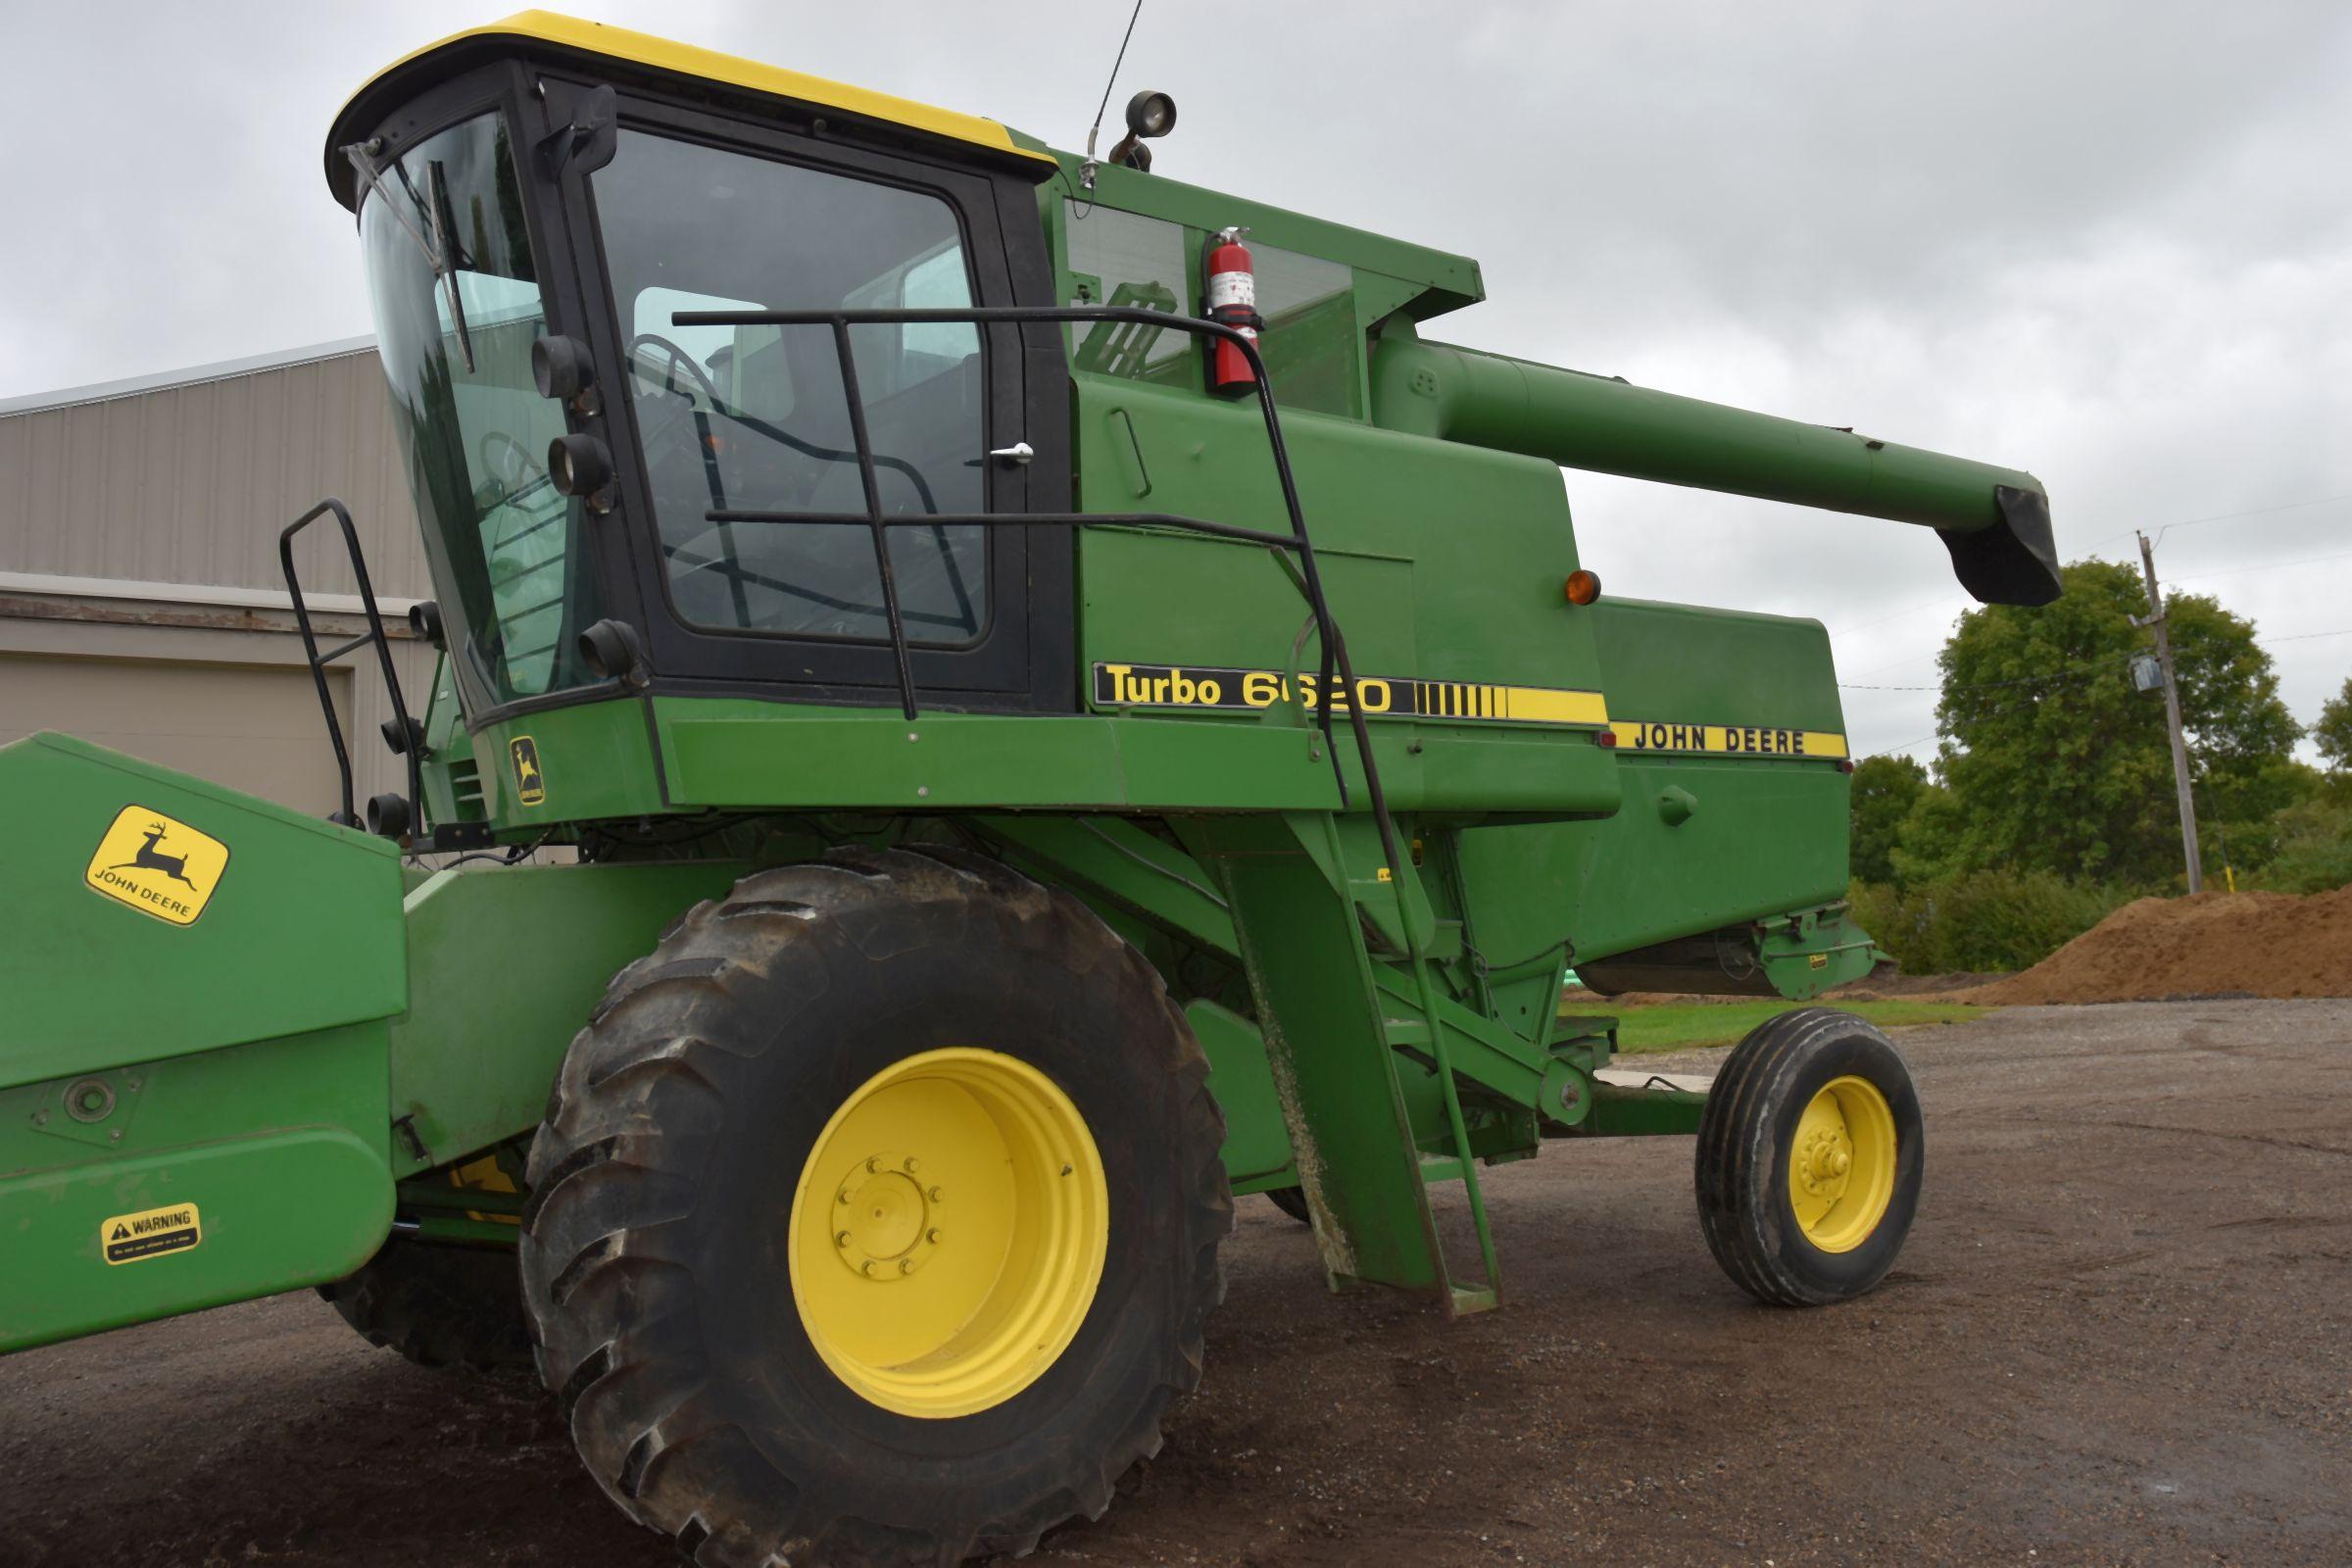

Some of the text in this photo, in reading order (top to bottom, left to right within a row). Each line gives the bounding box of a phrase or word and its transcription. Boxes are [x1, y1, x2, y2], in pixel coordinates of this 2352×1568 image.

[1105, 664, 1221, 705] Turbo
[1635, 724, 1805, 754] JOHN DEERE
[94, 869, 191, 917] JOHN DEERE
[132, 1210, 191, 1235] WARNING
